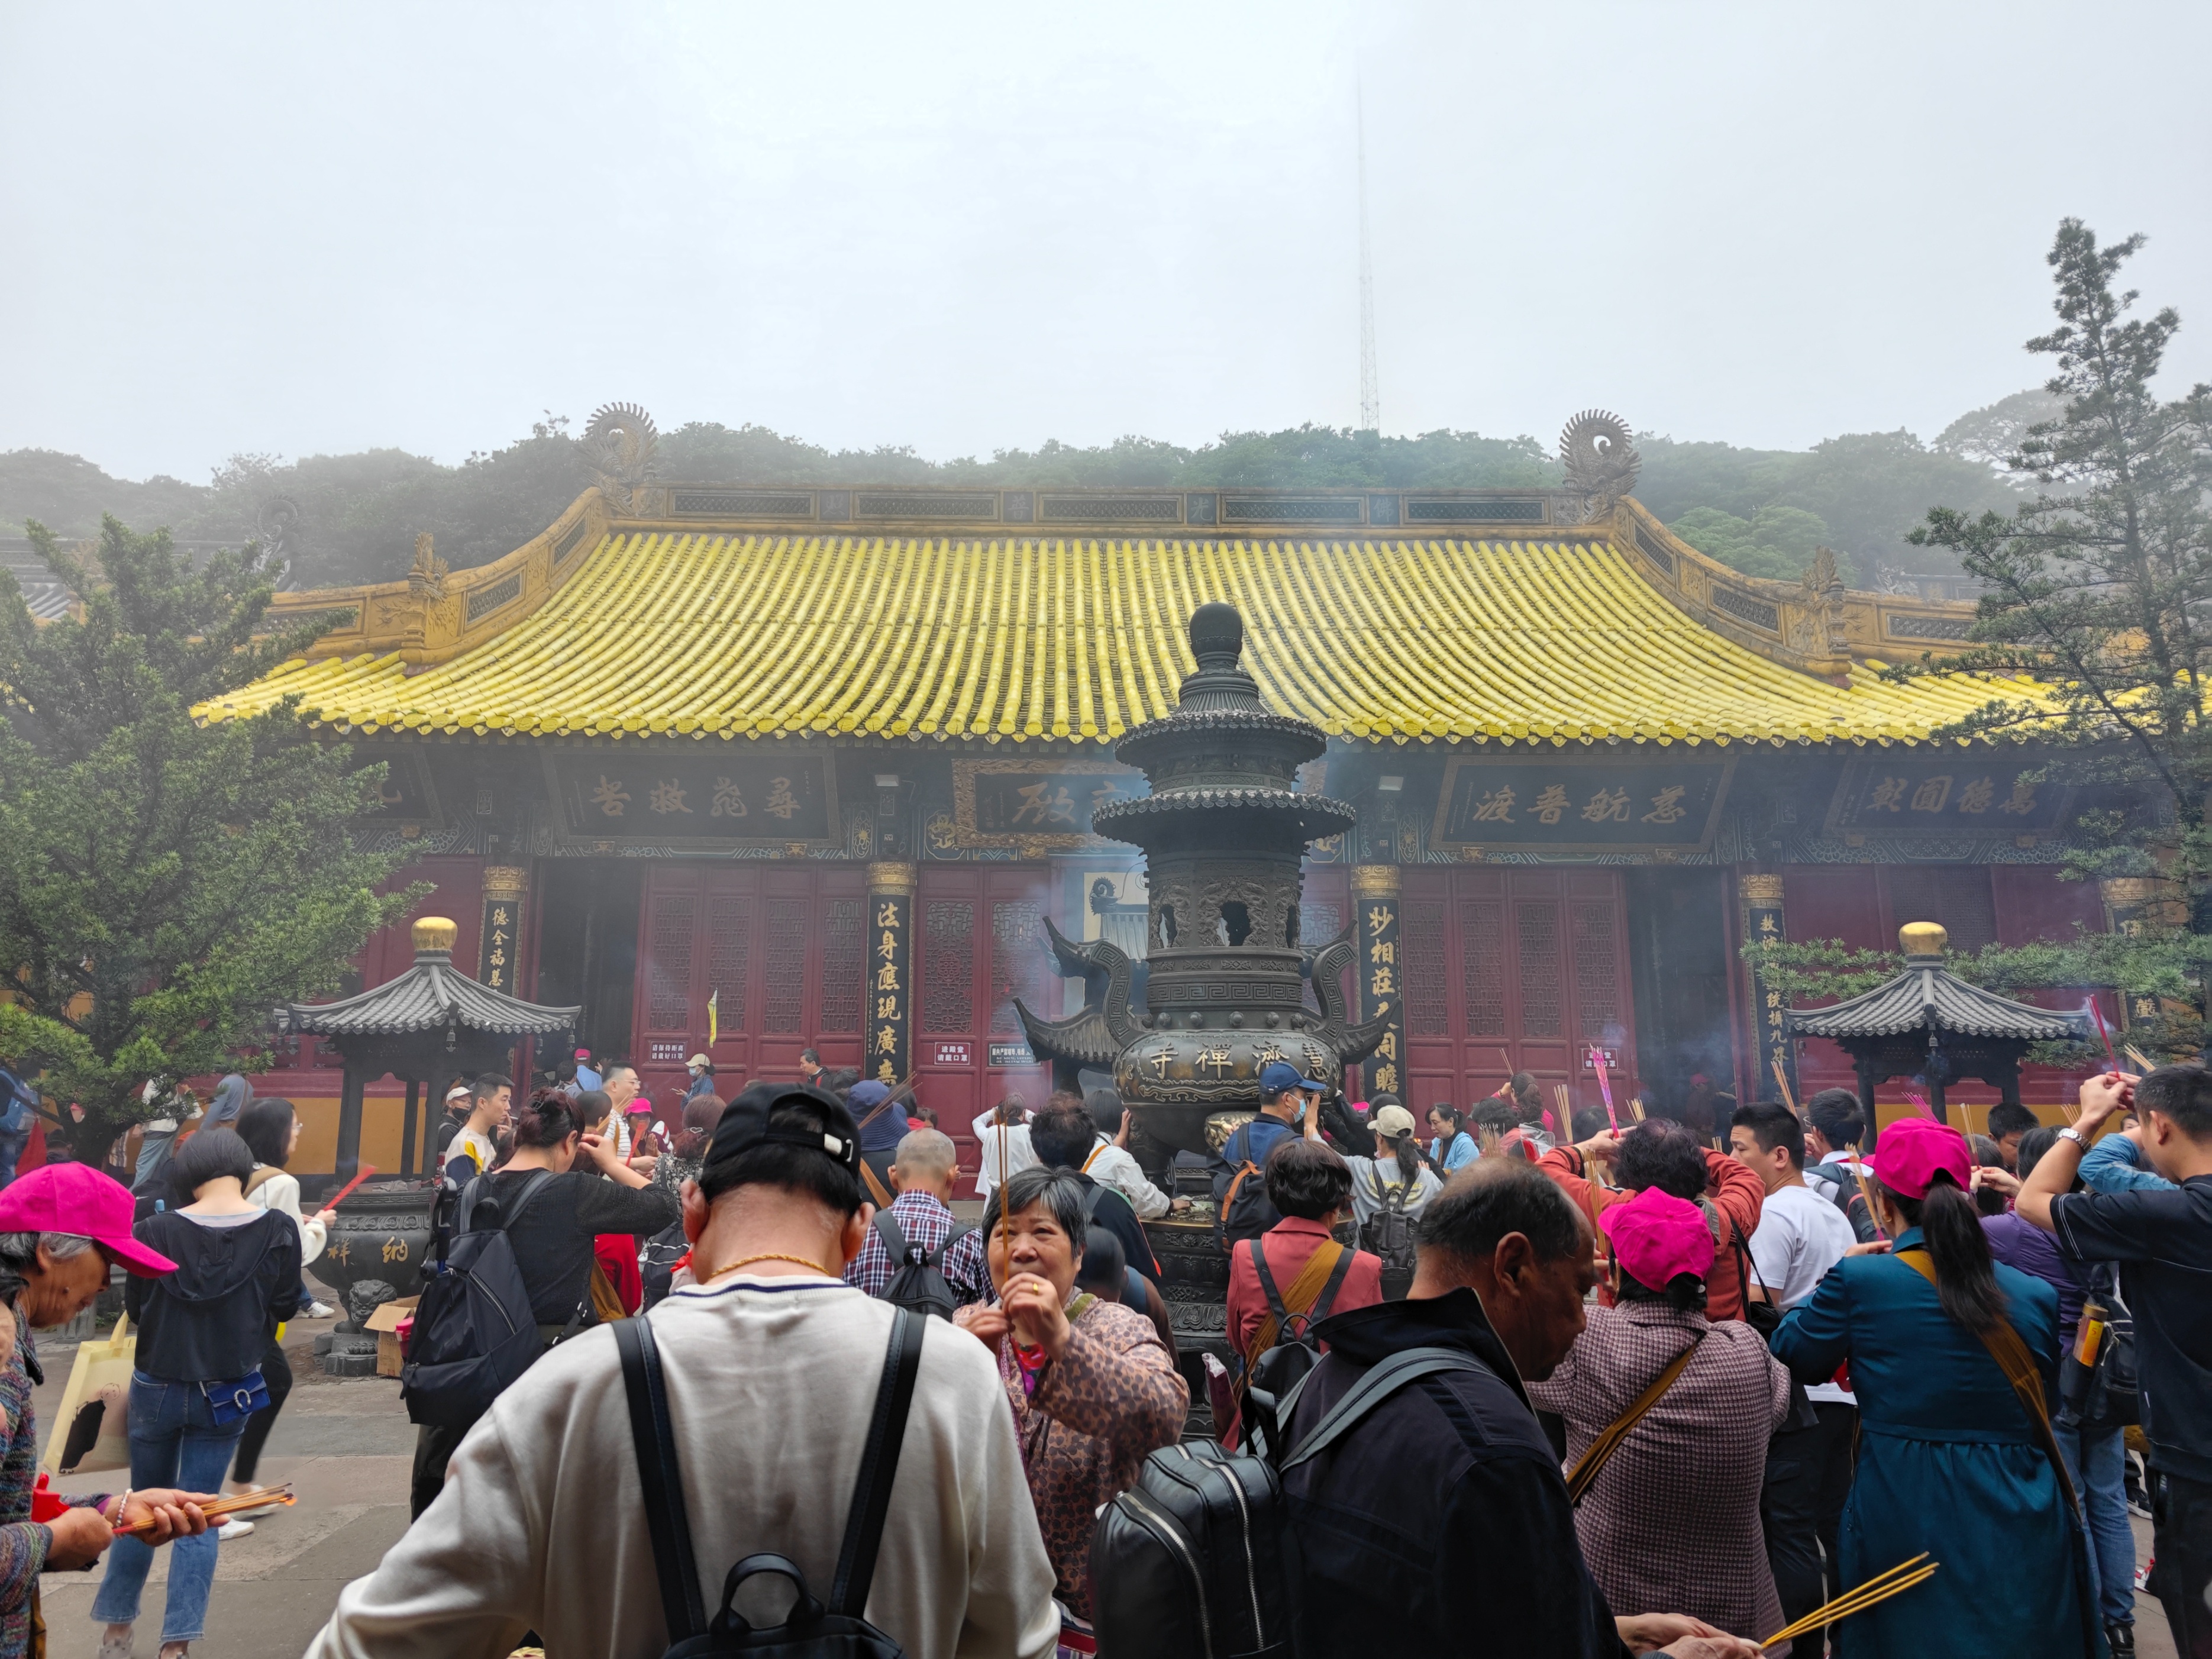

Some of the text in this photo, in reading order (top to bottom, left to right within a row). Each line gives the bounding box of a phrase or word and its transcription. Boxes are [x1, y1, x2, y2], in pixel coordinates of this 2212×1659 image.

[1472, 783, 1687, 825] 慈航普渡
[488, 906, 510, 992] 德全福慧
[937, 1054, 968, 1062] 请戴口罩
[1149, 1040, 1330, 1082] 慧濟禪寺
